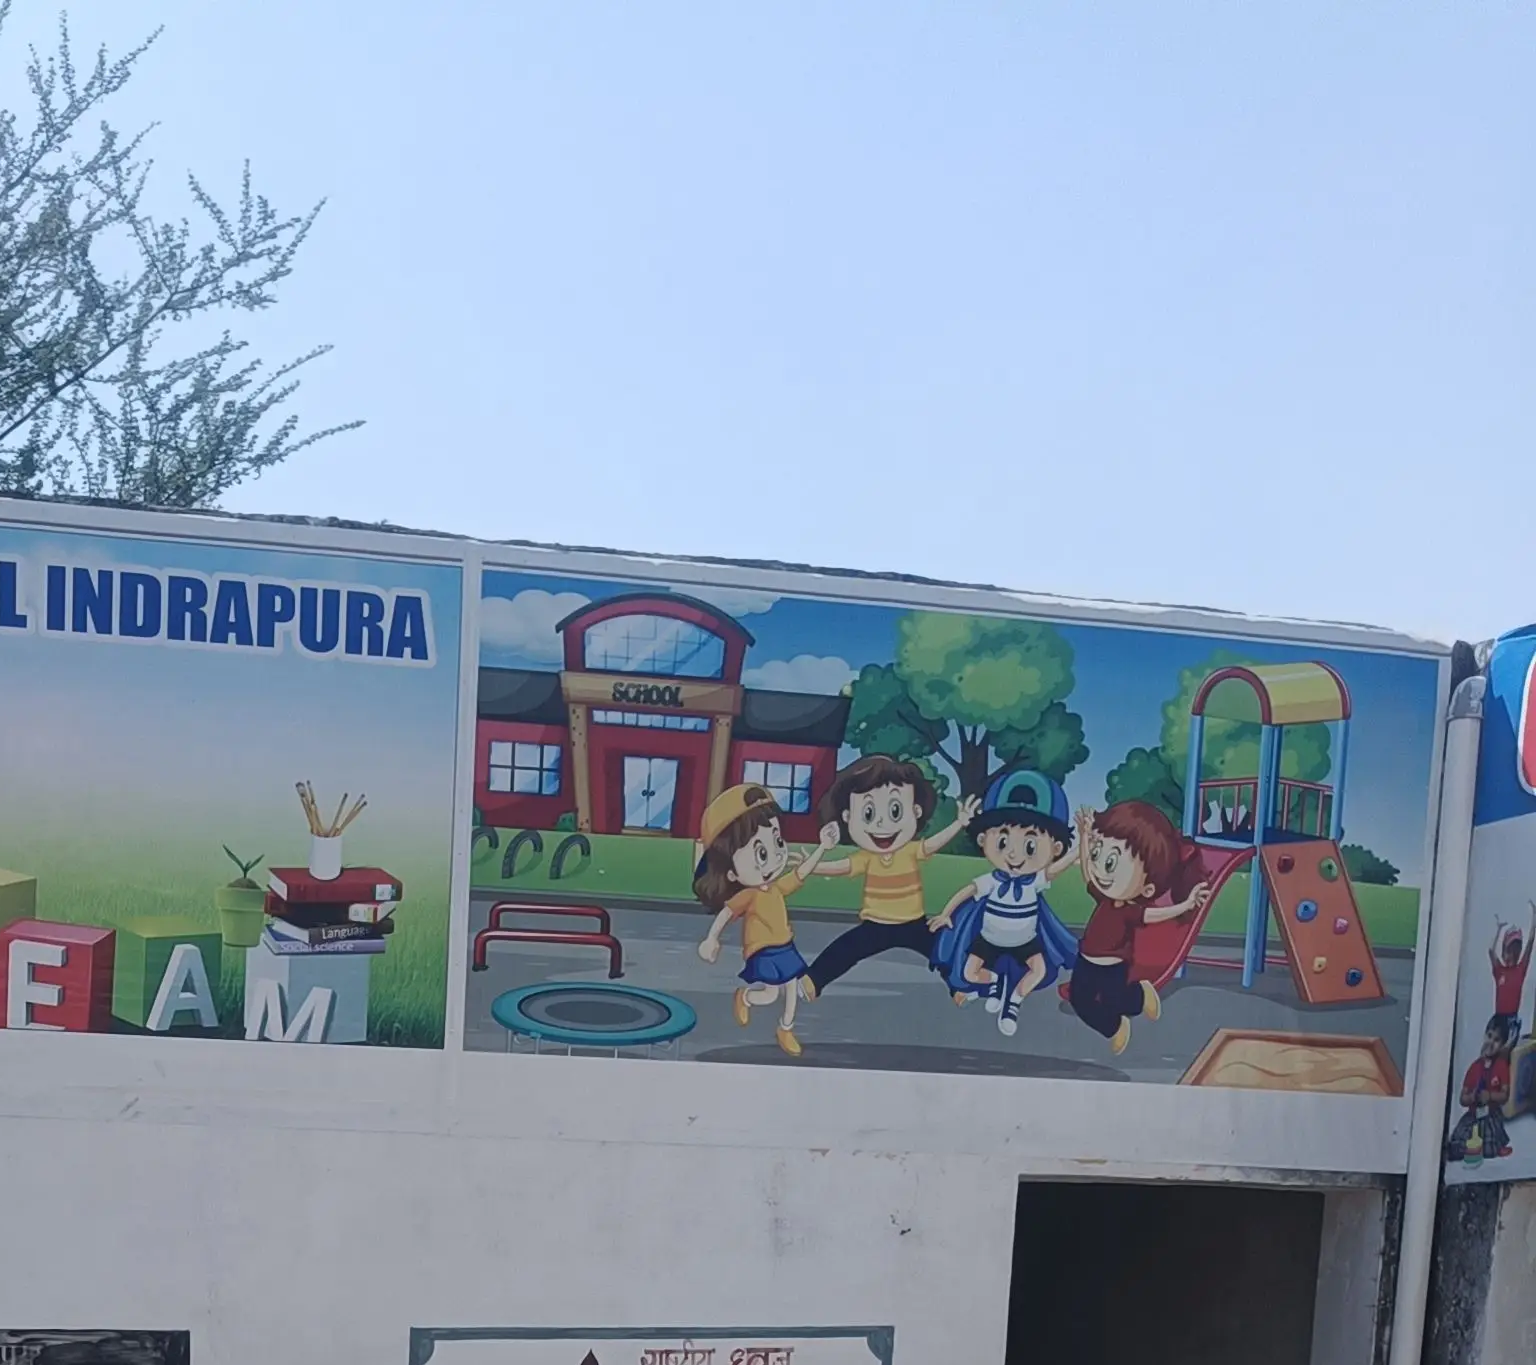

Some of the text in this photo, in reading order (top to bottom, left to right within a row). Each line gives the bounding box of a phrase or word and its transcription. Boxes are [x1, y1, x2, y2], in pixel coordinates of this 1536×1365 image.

[46, 565, 428, 660] INDRAPURA
[611, 682, 684, 707] SCHOOL
[315, 941, 354, 952] science
